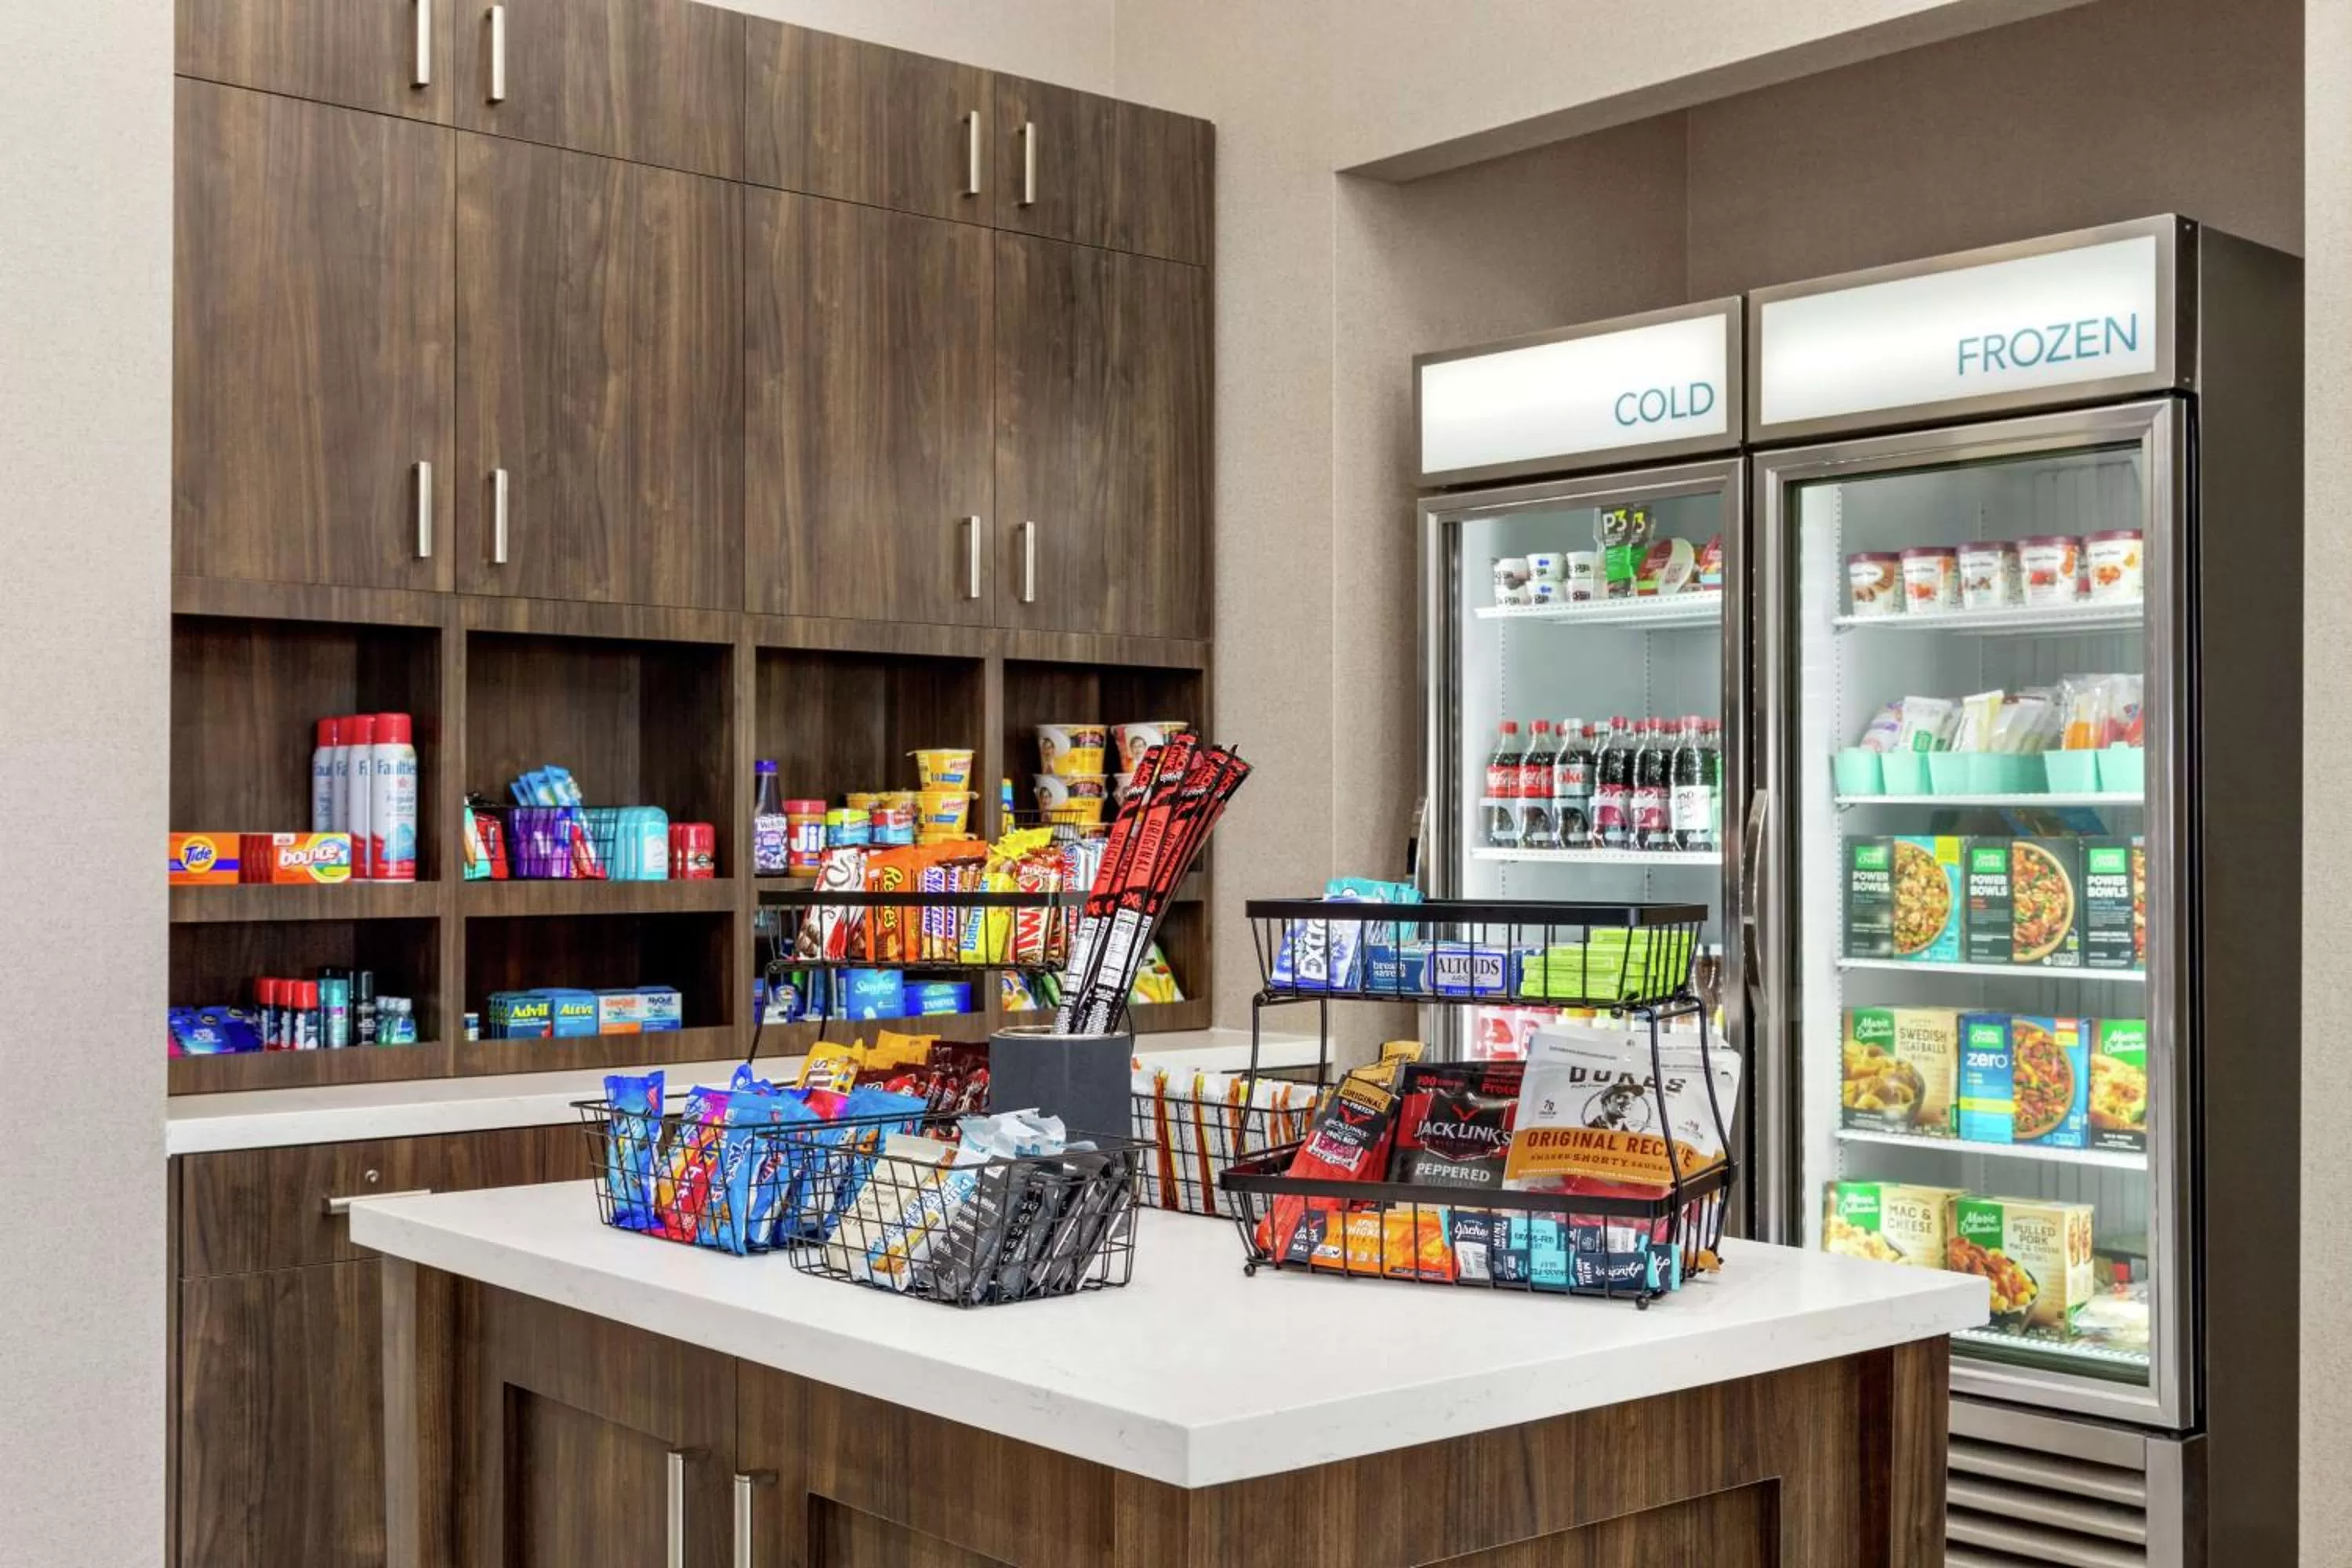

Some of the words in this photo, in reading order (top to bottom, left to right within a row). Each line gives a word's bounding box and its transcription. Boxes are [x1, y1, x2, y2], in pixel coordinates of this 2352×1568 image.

[1959, 313, 2136, 376] FROZEN
[1615, 382, 1715, 426] COLD
[1136, 819, 1163, 873] ORIGINAL
[185, 846, 212, 864] Tide
[280, 844, 338, 866] bounce
[1853, 871, 1889, 881] POWER
[1969, 874, 2008, 885] POWER
[2087, 875, 2127, 886] POWER
[1853, 881, 1890, 892] BOWLS
[1969, 885, 2009, 896] BOWLS
[2087, 887, 2129, 898] BOWLS
[511, 1003, 549, 1018] Advil
[1899, 1028, 1947, 1040] SWEDISH
[1966, 1052, 2009, 1069] zero
[1342, 1088, 1383, 1108] ORIGINAL
[1414, 1120, 1456, 1140] JACK
[1527, 1131, 1617, 1152] ORIGINAL
[1571, 1153, 1628, 1167] SHORTY
[1414, 1162, 1490, 1182] PEPPERED
[2013, 1222, 2057, 1236] PULLED
